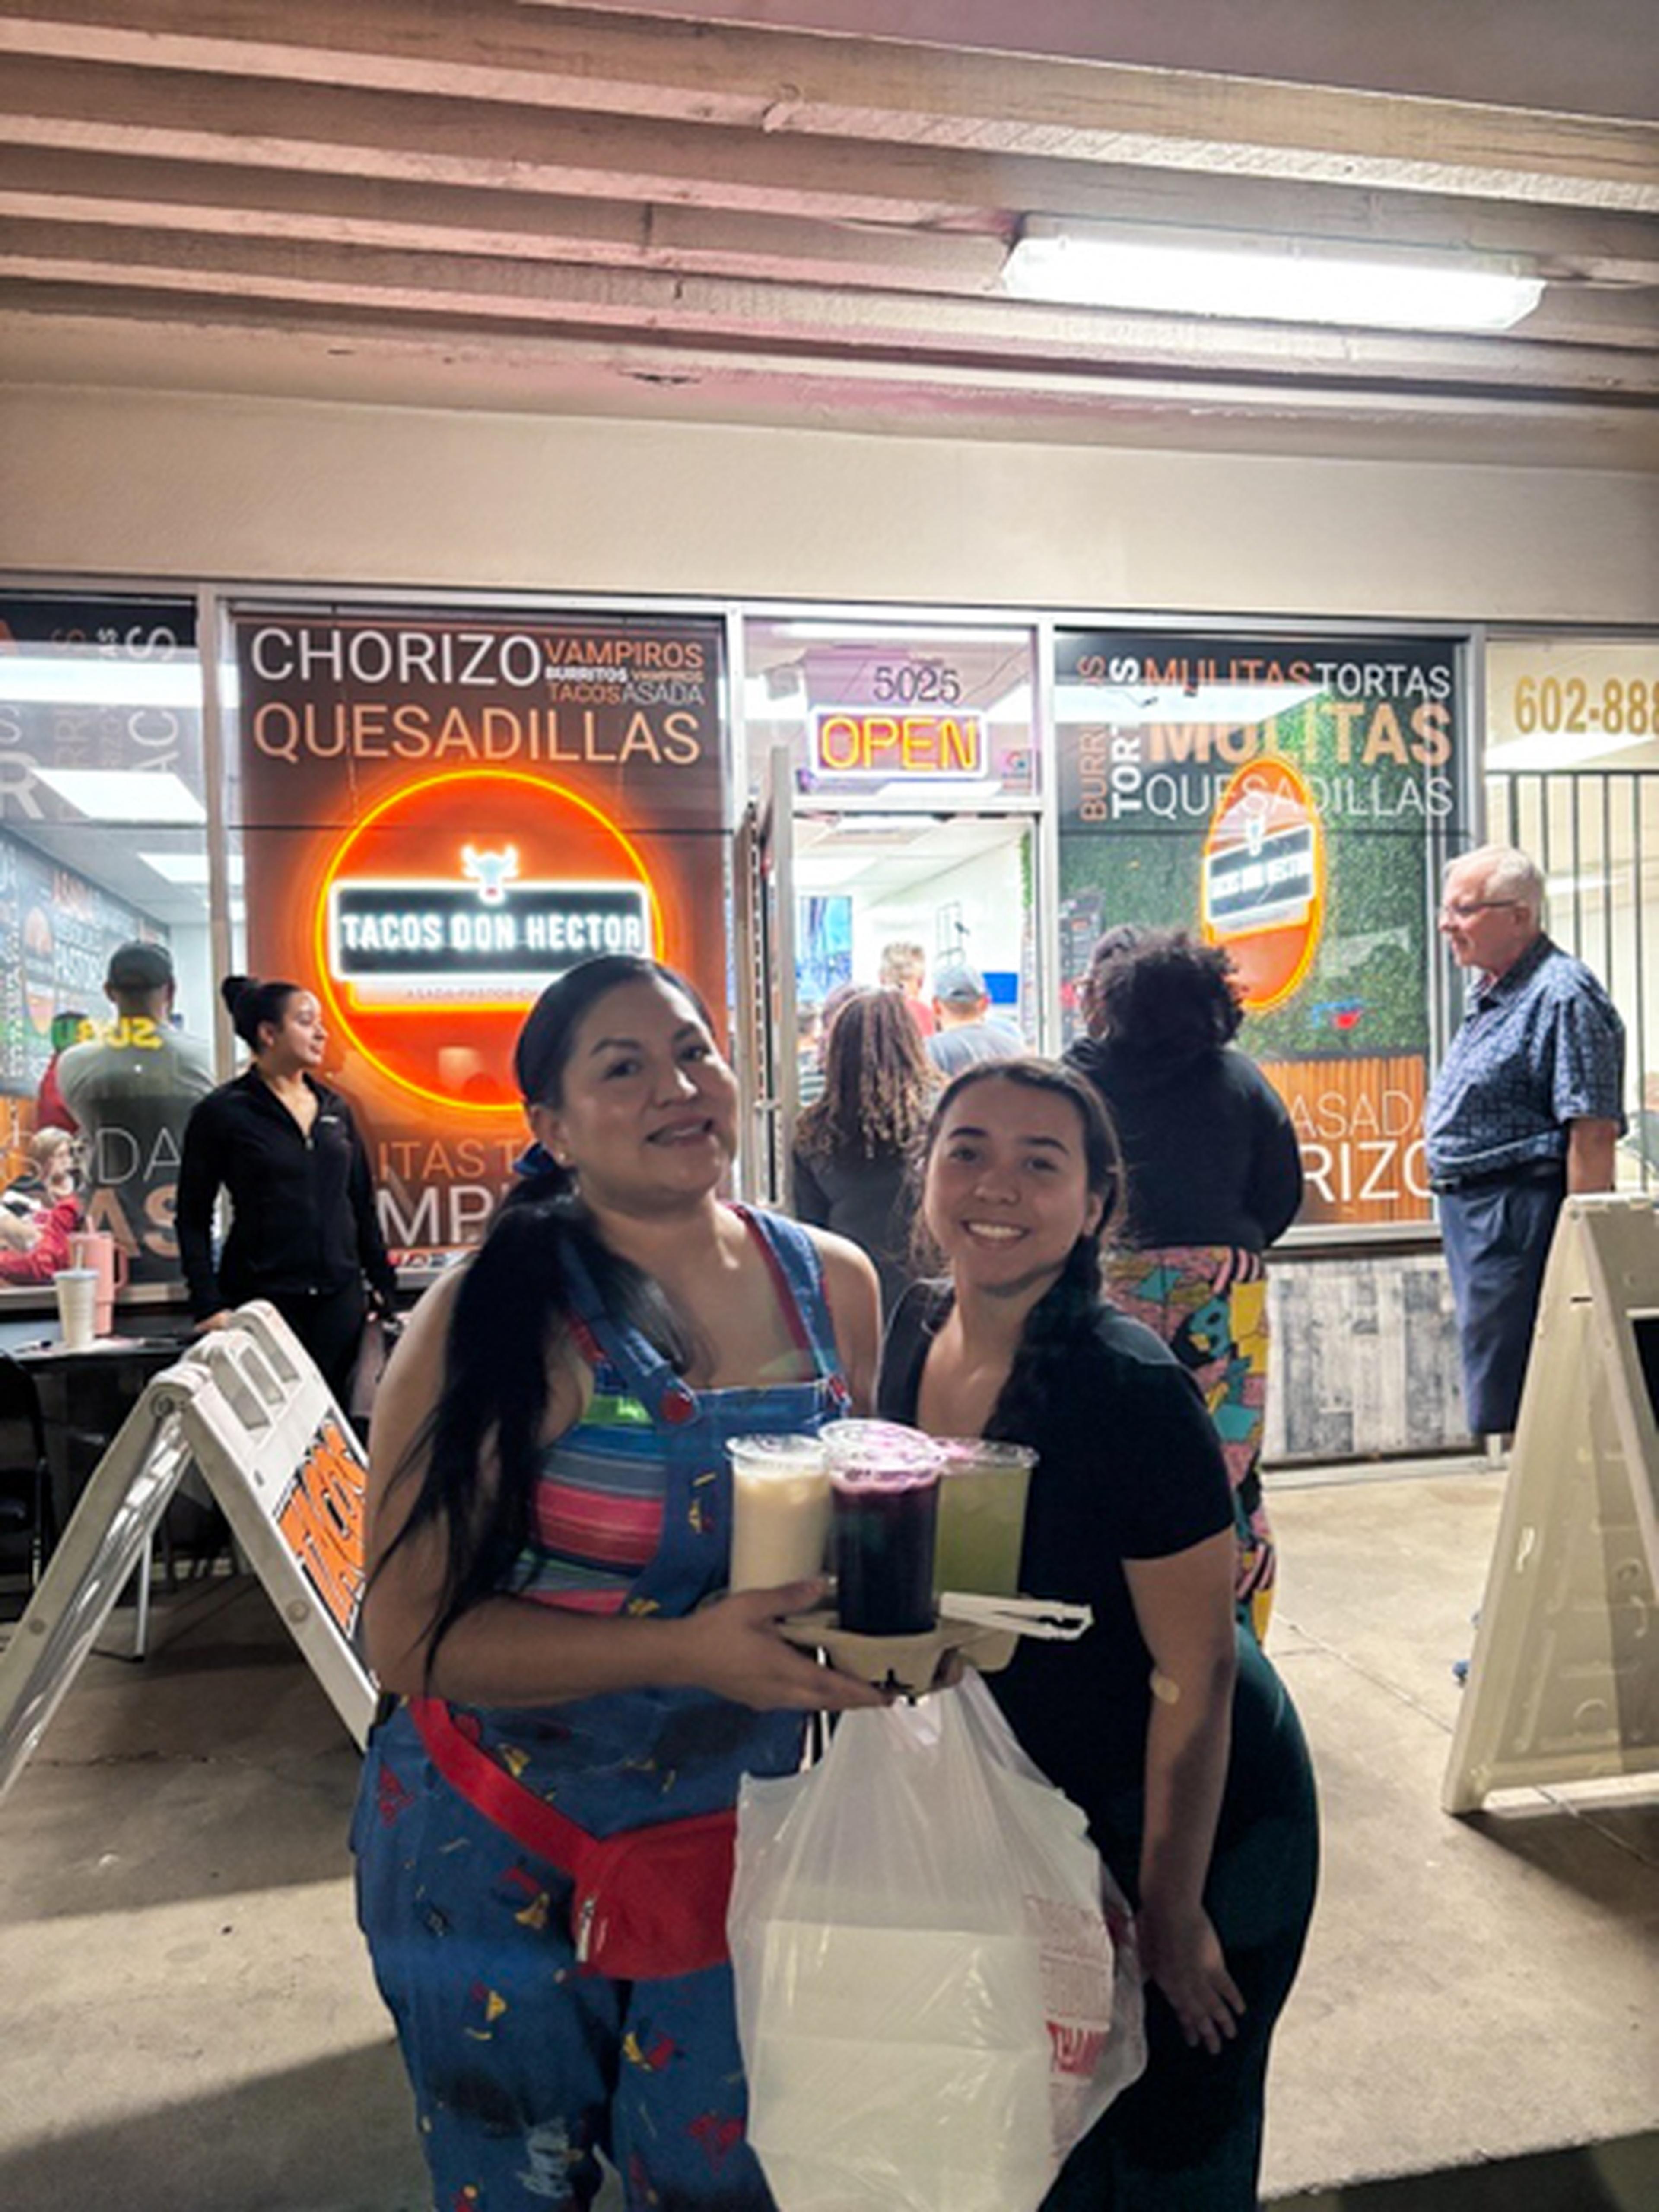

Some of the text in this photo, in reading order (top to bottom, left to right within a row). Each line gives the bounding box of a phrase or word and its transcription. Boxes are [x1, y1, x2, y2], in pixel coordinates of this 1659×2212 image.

[251, 627, 541, 687] CHORIZO
[544, 638, 705, 668] VAMPIROS
[549, 682, 621, 705] TACOS
[621, 681, 705, 706] ASADA
[874, 666, 960, 702] 5025
[1315, 662, 1452, 699] TORTAS
[253, 702, 701, 764] QUESADILLAS
[821, 714, 978, 769] OPEN
[341, 912, 640, 952] TACOS DON HECTOR
[1292, 1091, 1425, 1138] ASAD
